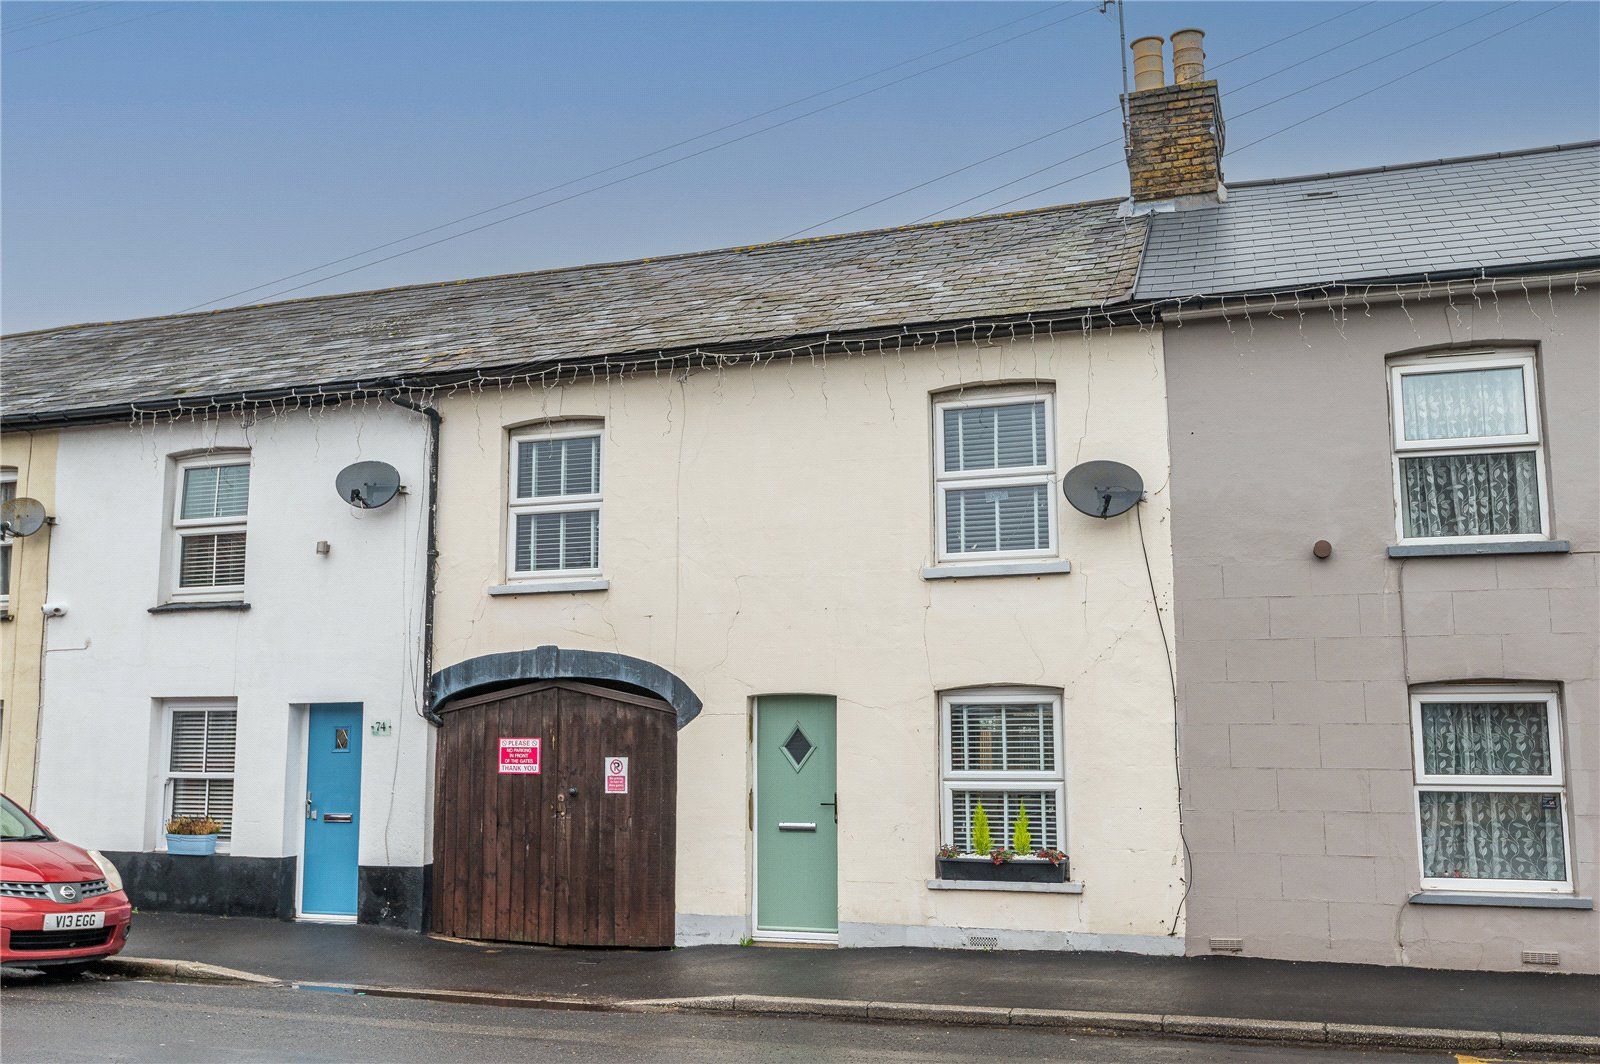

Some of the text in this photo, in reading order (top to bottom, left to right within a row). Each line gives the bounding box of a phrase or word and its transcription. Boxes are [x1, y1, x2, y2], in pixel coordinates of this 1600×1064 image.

[375, 721, 386, 732] 74
[56, 914, 96, 928] V13 EGG
